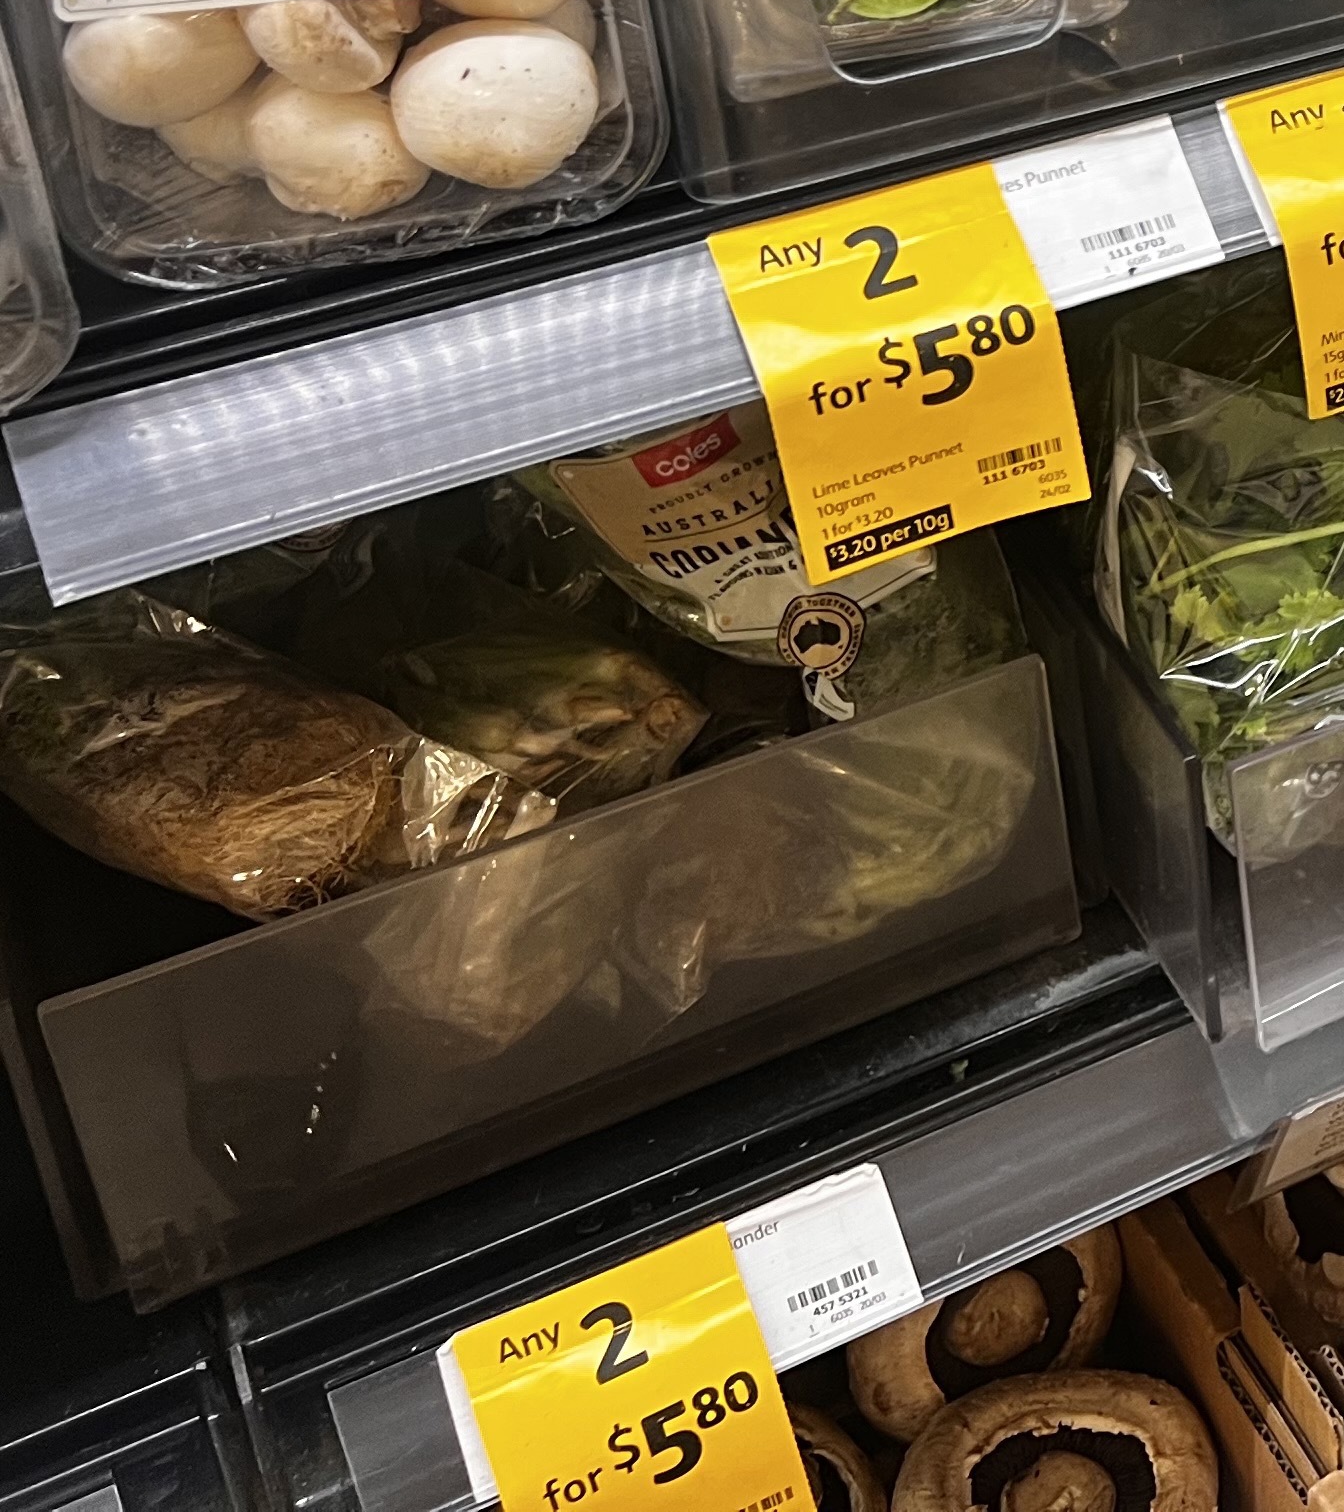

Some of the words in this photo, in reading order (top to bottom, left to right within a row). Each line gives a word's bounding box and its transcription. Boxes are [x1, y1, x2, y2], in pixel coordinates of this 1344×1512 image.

[1270, 100, 1325, 134] Any
[759, 237, 822, 272] Any
[845, 225, 919, 300] 2
[808, 374, 874, 415] for
[654, 431, 722, 478] coles
[812, 477, 849, 499] Lime
[853, 462, 902, 490] Leaves
[905, 441, 965, 470] Punnet
[829, 535, 876, 564] $3.20
[881, 526, 912, 555] per
[914, 513, 951, 539] 10g
[499, 1321, 561, 1364] Any
[580, 1301, 649, 1386] 2
[543, 1467, 603, 1511] for
